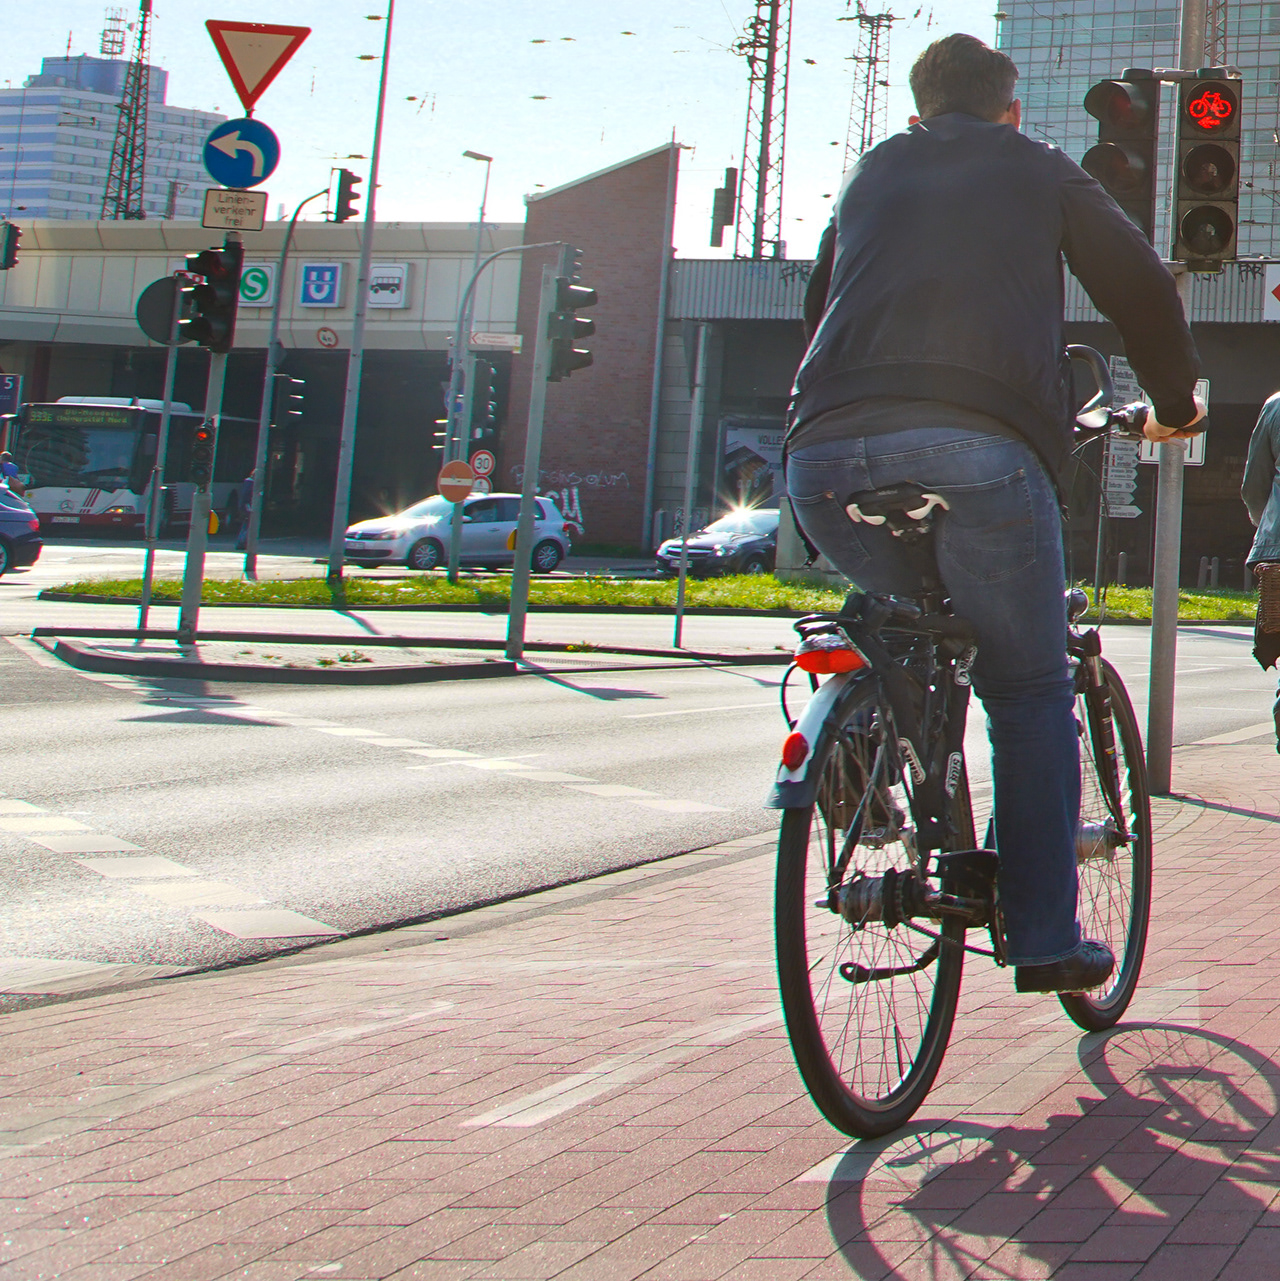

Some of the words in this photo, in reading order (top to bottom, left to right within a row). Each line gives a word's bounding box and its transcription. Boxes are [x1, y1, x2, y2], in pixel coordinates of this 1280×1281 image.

[217, 193, 255, 205] Linien-
[214, 205, 257, 216] verkehr
[225, 215, 244, 226] frei
[4, 376, 14, 390] 5
[475, 457, 490, 470] 30
